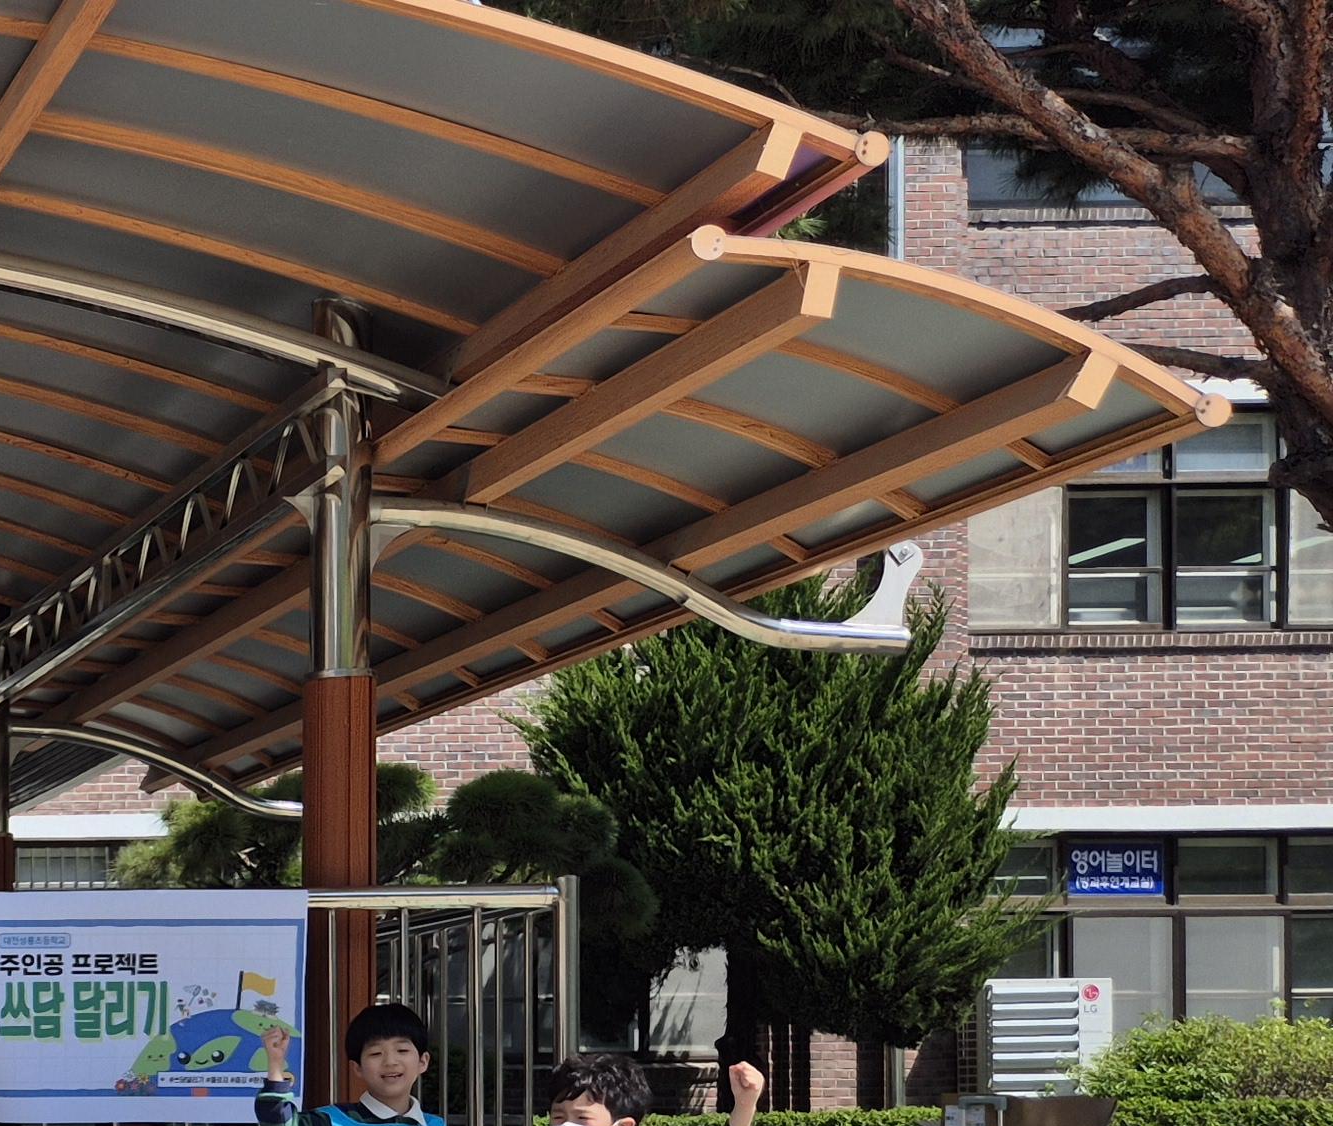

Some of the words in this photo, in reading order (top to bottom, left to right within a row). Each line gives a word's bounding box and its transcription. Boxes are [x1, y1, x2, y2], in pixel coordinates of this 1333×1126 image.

[1071, 850, 1157, 874] 영어놀이터
[0, 954, 64, 975] 주인공
[71, 953, 159, 975] 프로젝트
[0, 981, 65, 1038] 쓰담
[73, 981, 168, 1038] 달리기
[1084, 1004, 1098, 1013] LG
